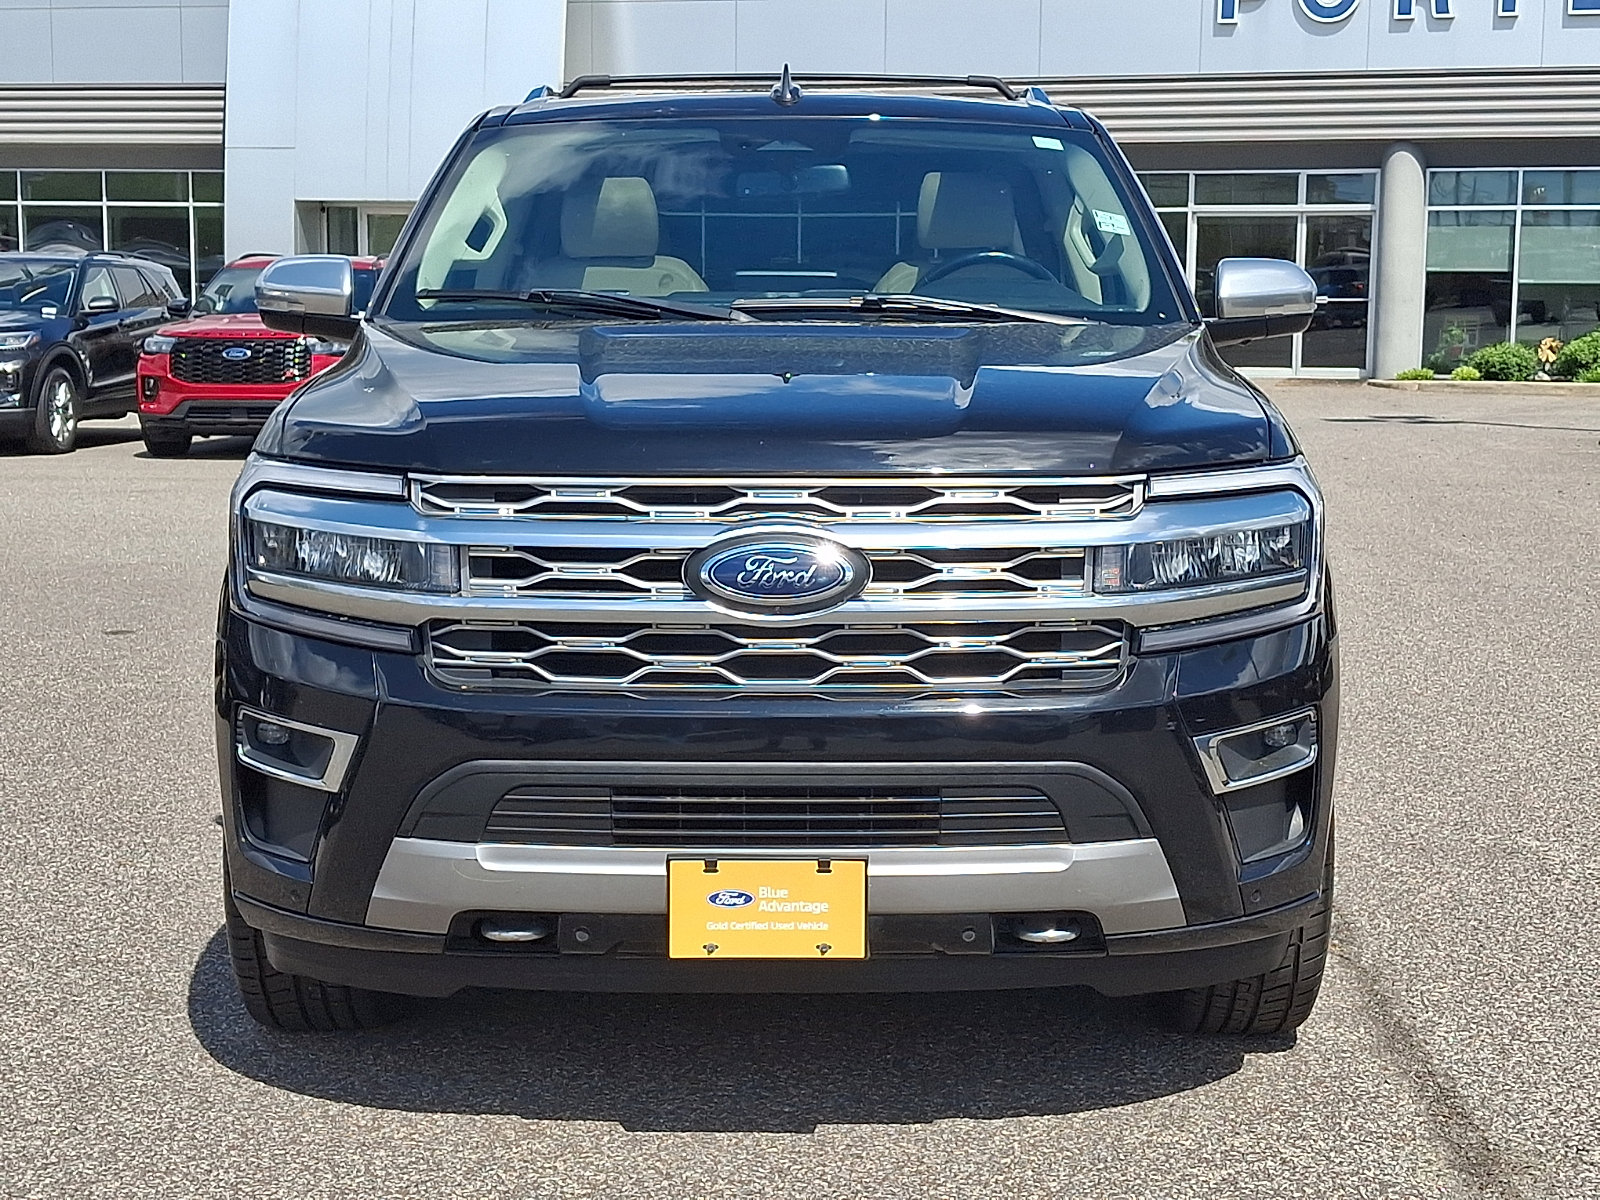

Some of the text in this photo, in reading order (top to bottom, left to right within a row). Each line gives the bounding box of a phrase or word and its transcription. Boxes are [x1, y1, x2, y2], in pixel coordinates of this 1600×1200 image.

[737, 555, 817, 589] Ford
[715, 891, 745, 904] Ford
[758, 886, 788, 898] Blue
[758, 900, 829, 914] Advantage
[706, 921, 829, 930] Gold Certified Used Vehicle
